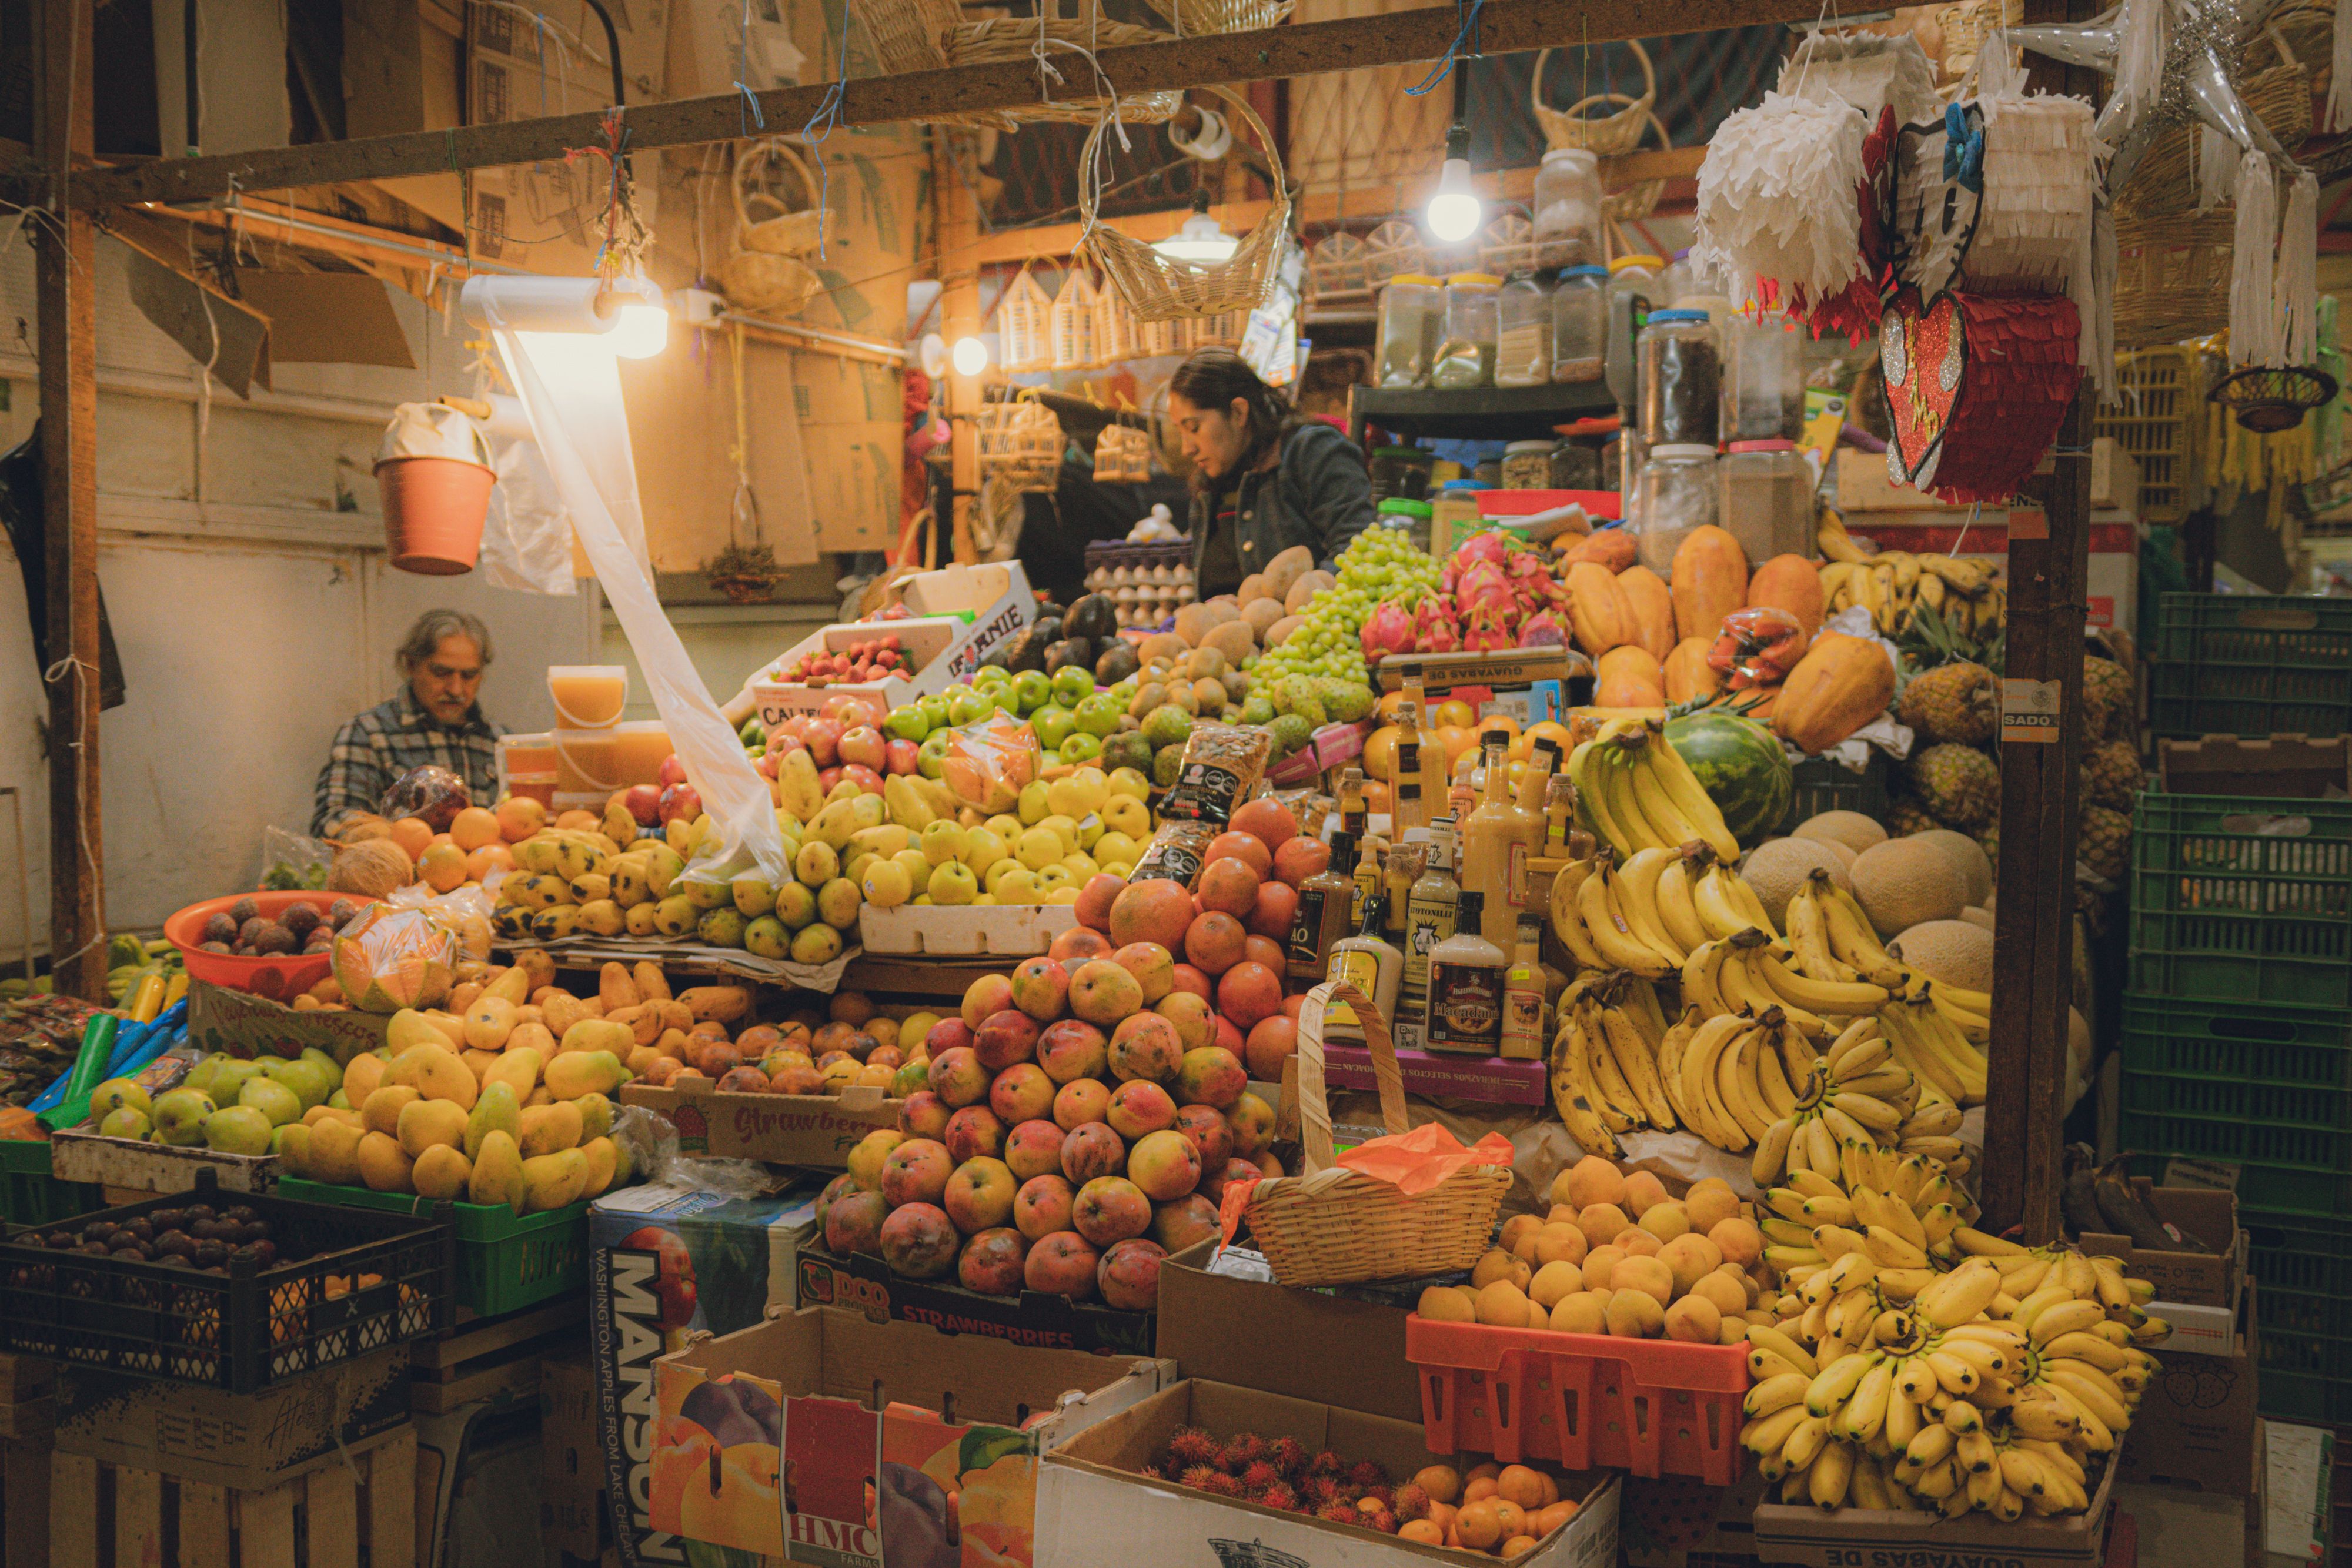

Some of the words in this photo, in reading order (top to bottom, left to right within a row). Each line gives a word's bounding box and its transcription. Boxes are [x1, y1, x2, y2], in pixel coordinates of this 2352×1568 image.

[1450, 666, 1522, 679] GUAYABAS
[2004, 715, 2050, 726] SADO
[1409, 1068, 1451, 1080] SELECTOS
[595, 1247, 610, 1356] WASHINGTON
[903, 1305, 1074, 1350] STRAWBERRIES
[600, 1359, 614, 1413] APPLES
[604, 1416, 619, 1460] FROM
[609, 1464, 624, 1500] LAKE
[614, 1503, 635, 1560] CHELAN
[789, 1514, 878, 1556] HMC
[841, 1553, 878, 1568] FARMS
[1825, 1550, 1863, 1567] DE
